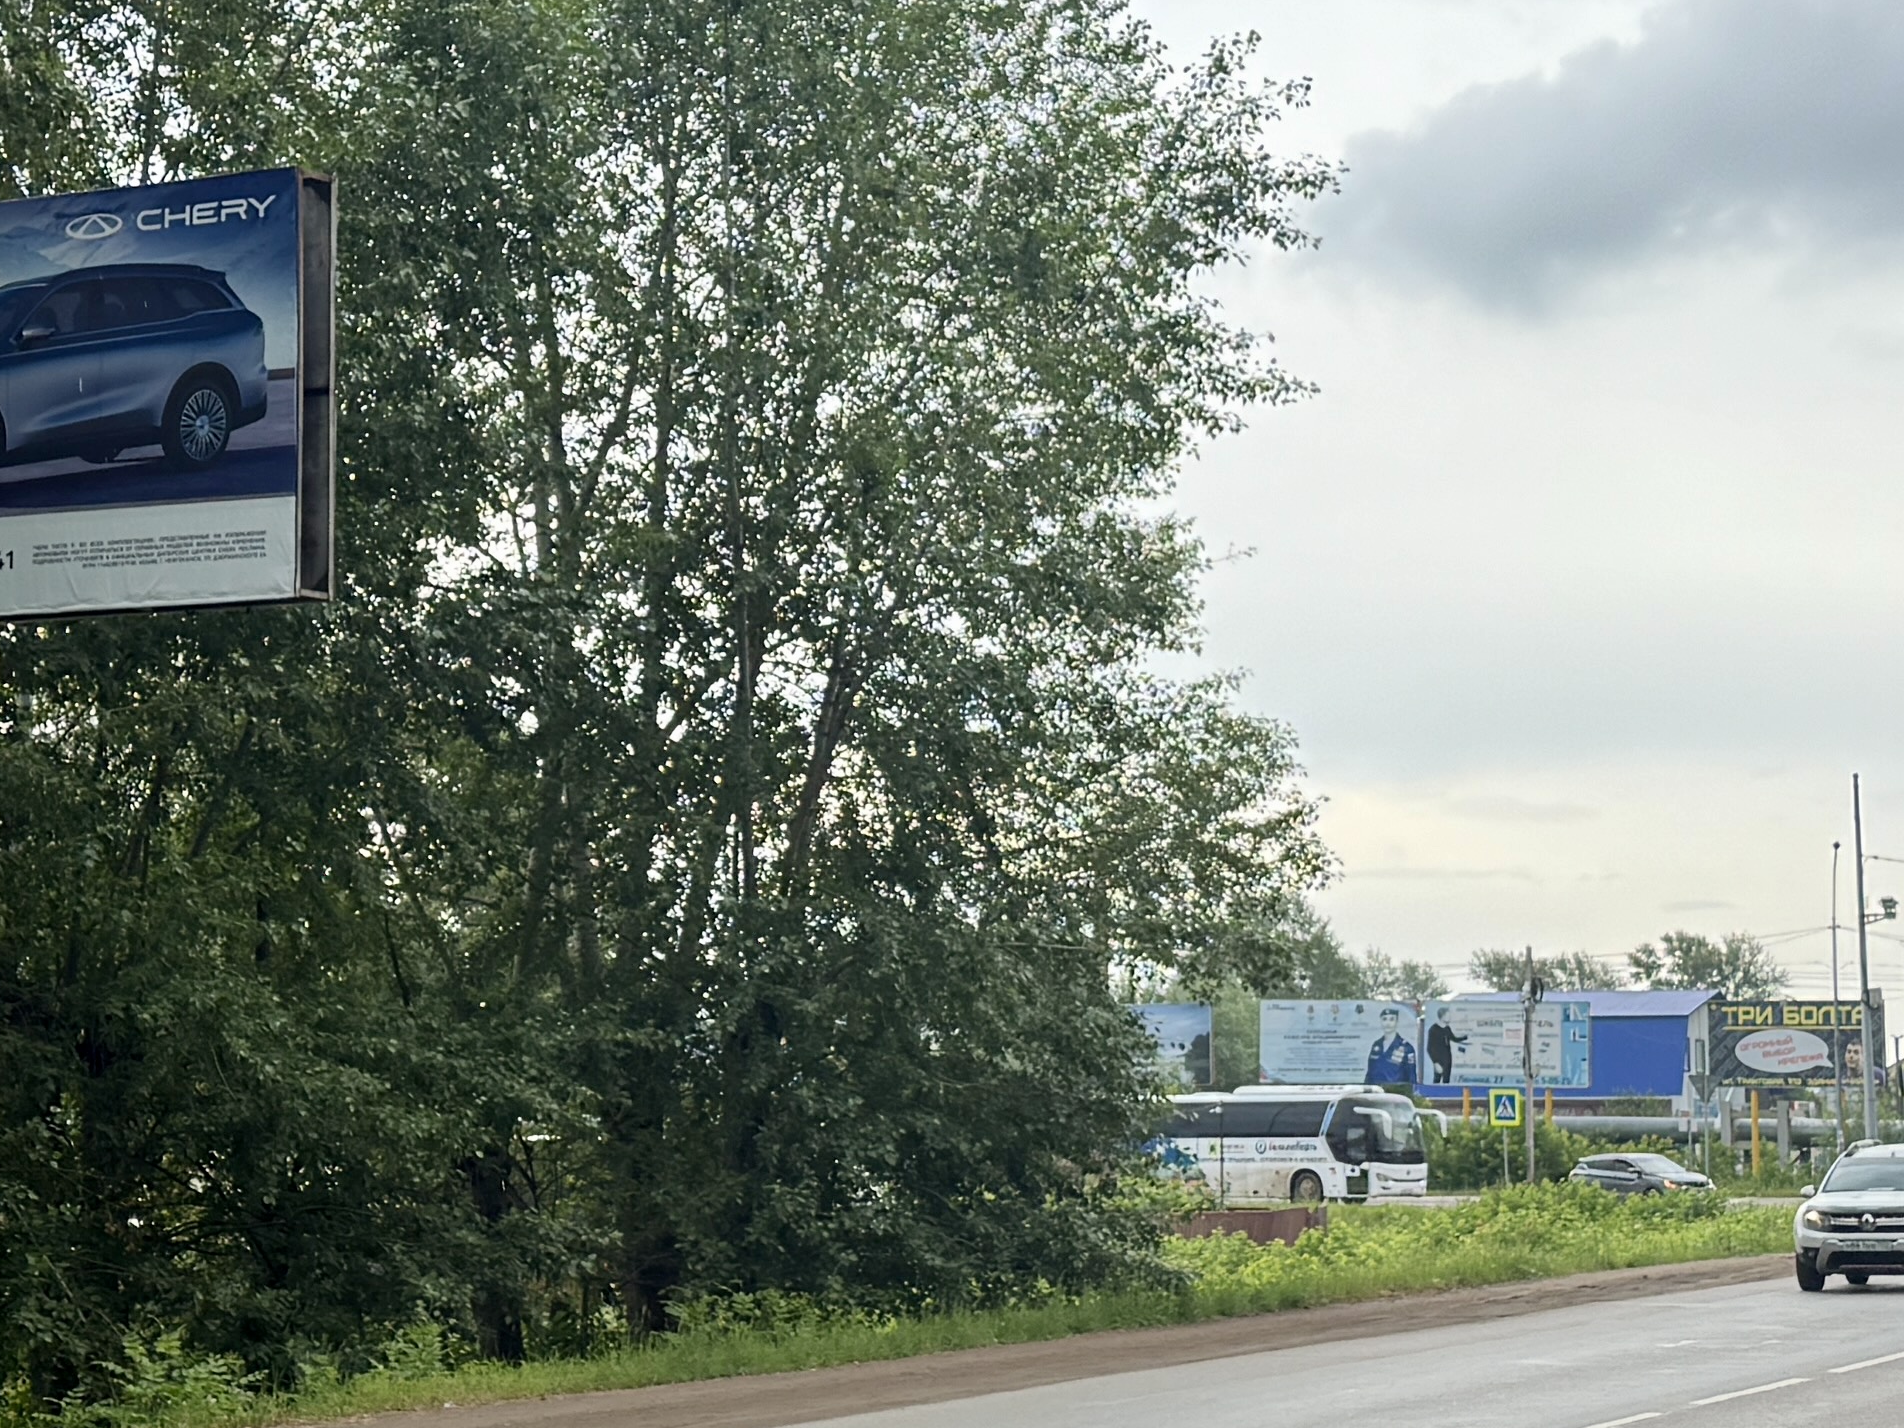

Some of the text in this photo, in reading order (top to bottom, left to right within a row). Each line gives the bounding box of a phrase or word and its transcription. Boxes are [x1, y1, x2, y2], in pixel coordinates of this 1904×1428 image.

[136, 195, 276, 231] CHERY
[1721, 1005, 1863, 1025] ТРИ БОЛТА
